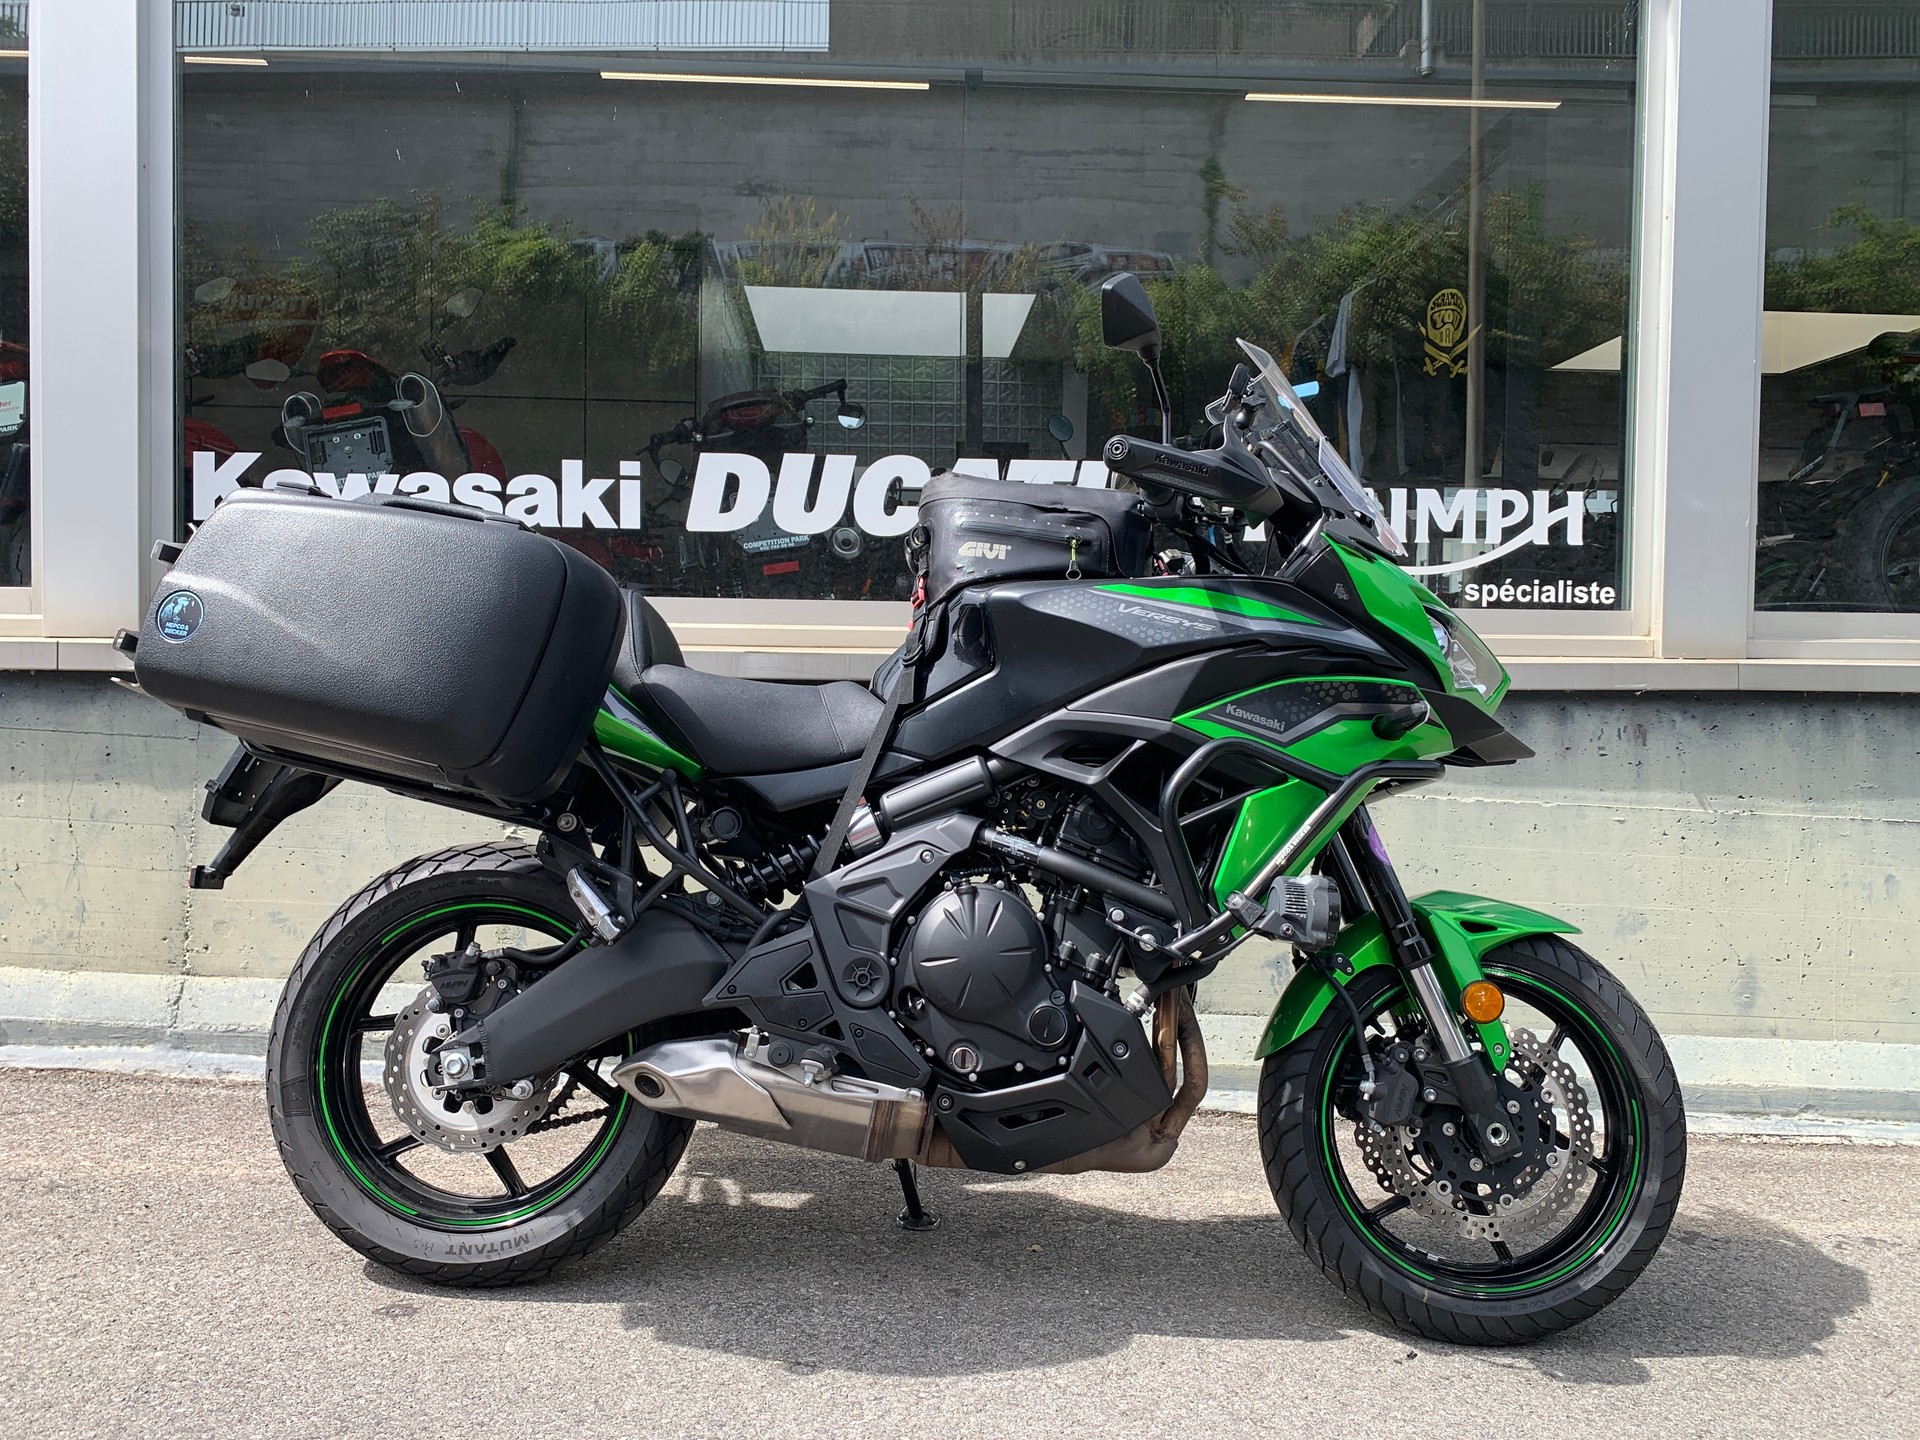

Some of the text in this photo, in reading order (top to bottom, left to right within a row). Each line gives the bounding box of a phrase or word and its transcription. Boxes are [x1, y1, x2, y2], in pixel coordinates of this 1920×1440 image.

[1155, 452, 1211, 477] Kawasaki
[743, 535, 810, 549] COMPETITION PARK
[958, 541, 1007, 560] GIVI
[1464, 578, 1616, 607] spécialiste
[1225, 703, 1286, 732] Kawasaki
[445, 1233, 531, 1256] MUTANT
